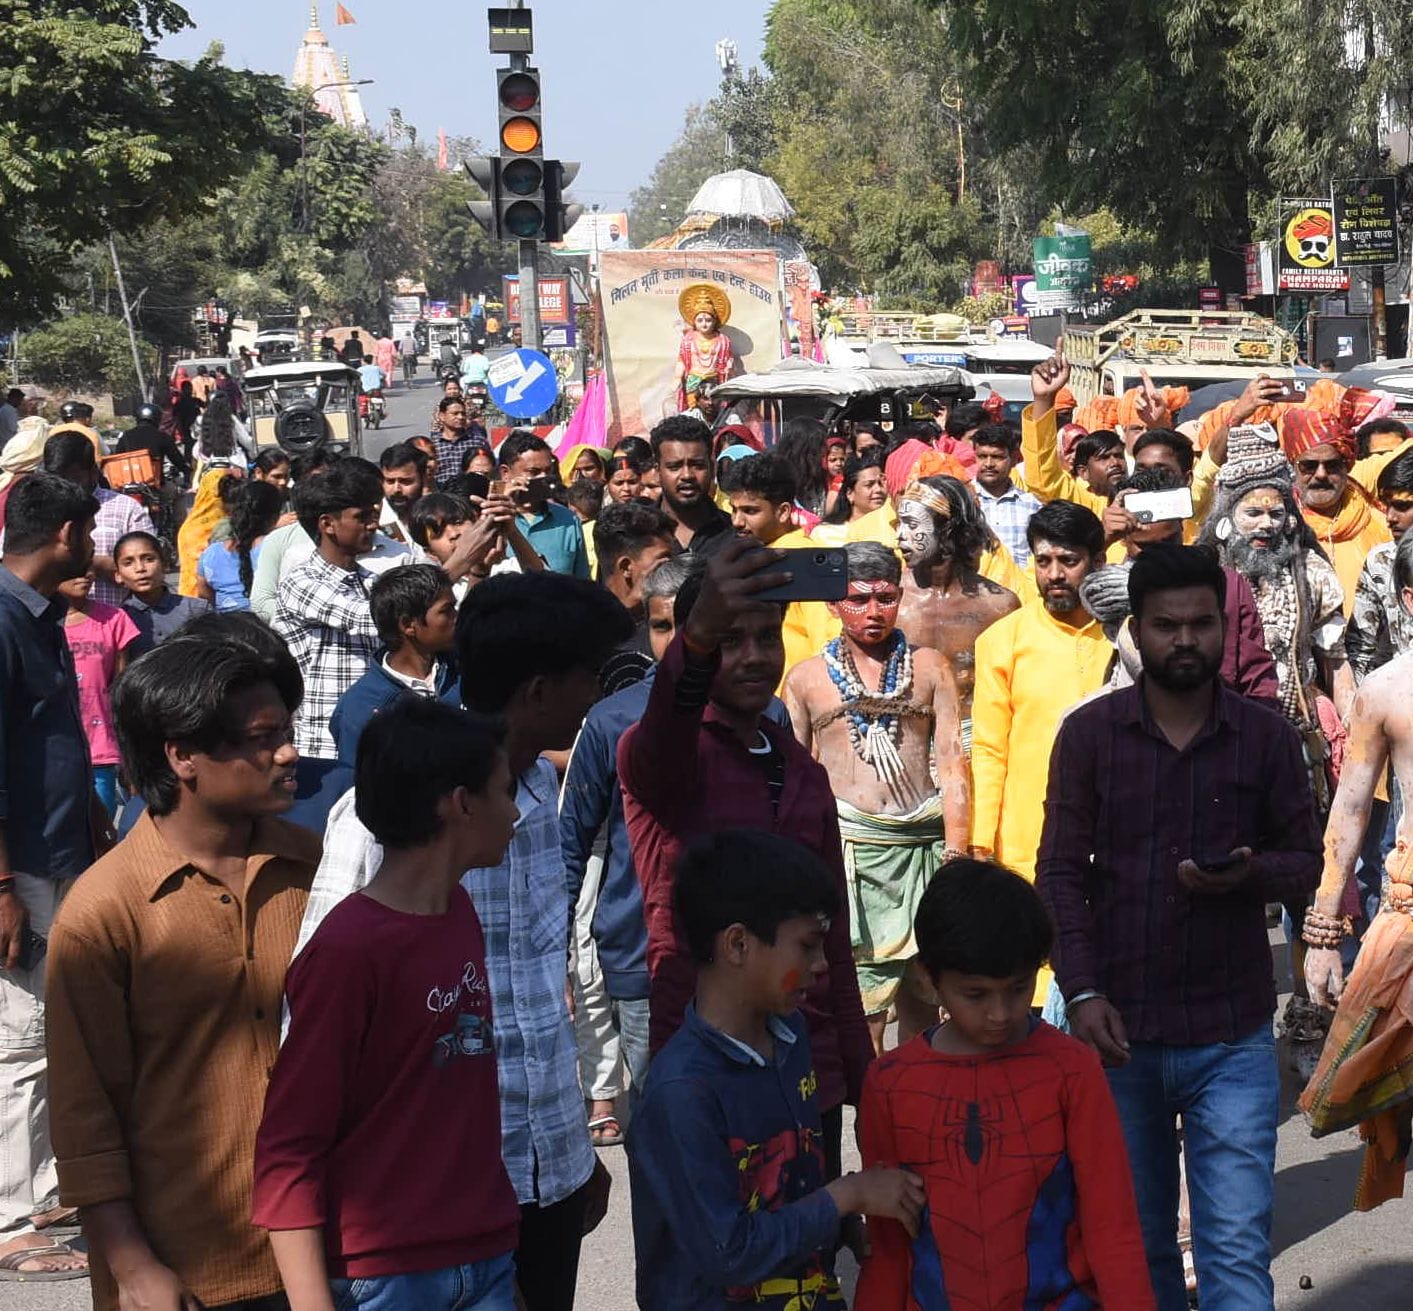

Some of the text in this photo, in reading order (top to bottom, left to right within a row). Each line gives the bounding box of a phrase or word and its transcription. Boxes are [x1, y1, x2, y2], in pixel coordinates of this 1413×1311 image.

[1280, 275, 1348, 284] CHAMPARAN
[543, 283, 561, 295] WAY
[610, 278, 638, 305] मिलन
[663, 269, 684, 280] कला
